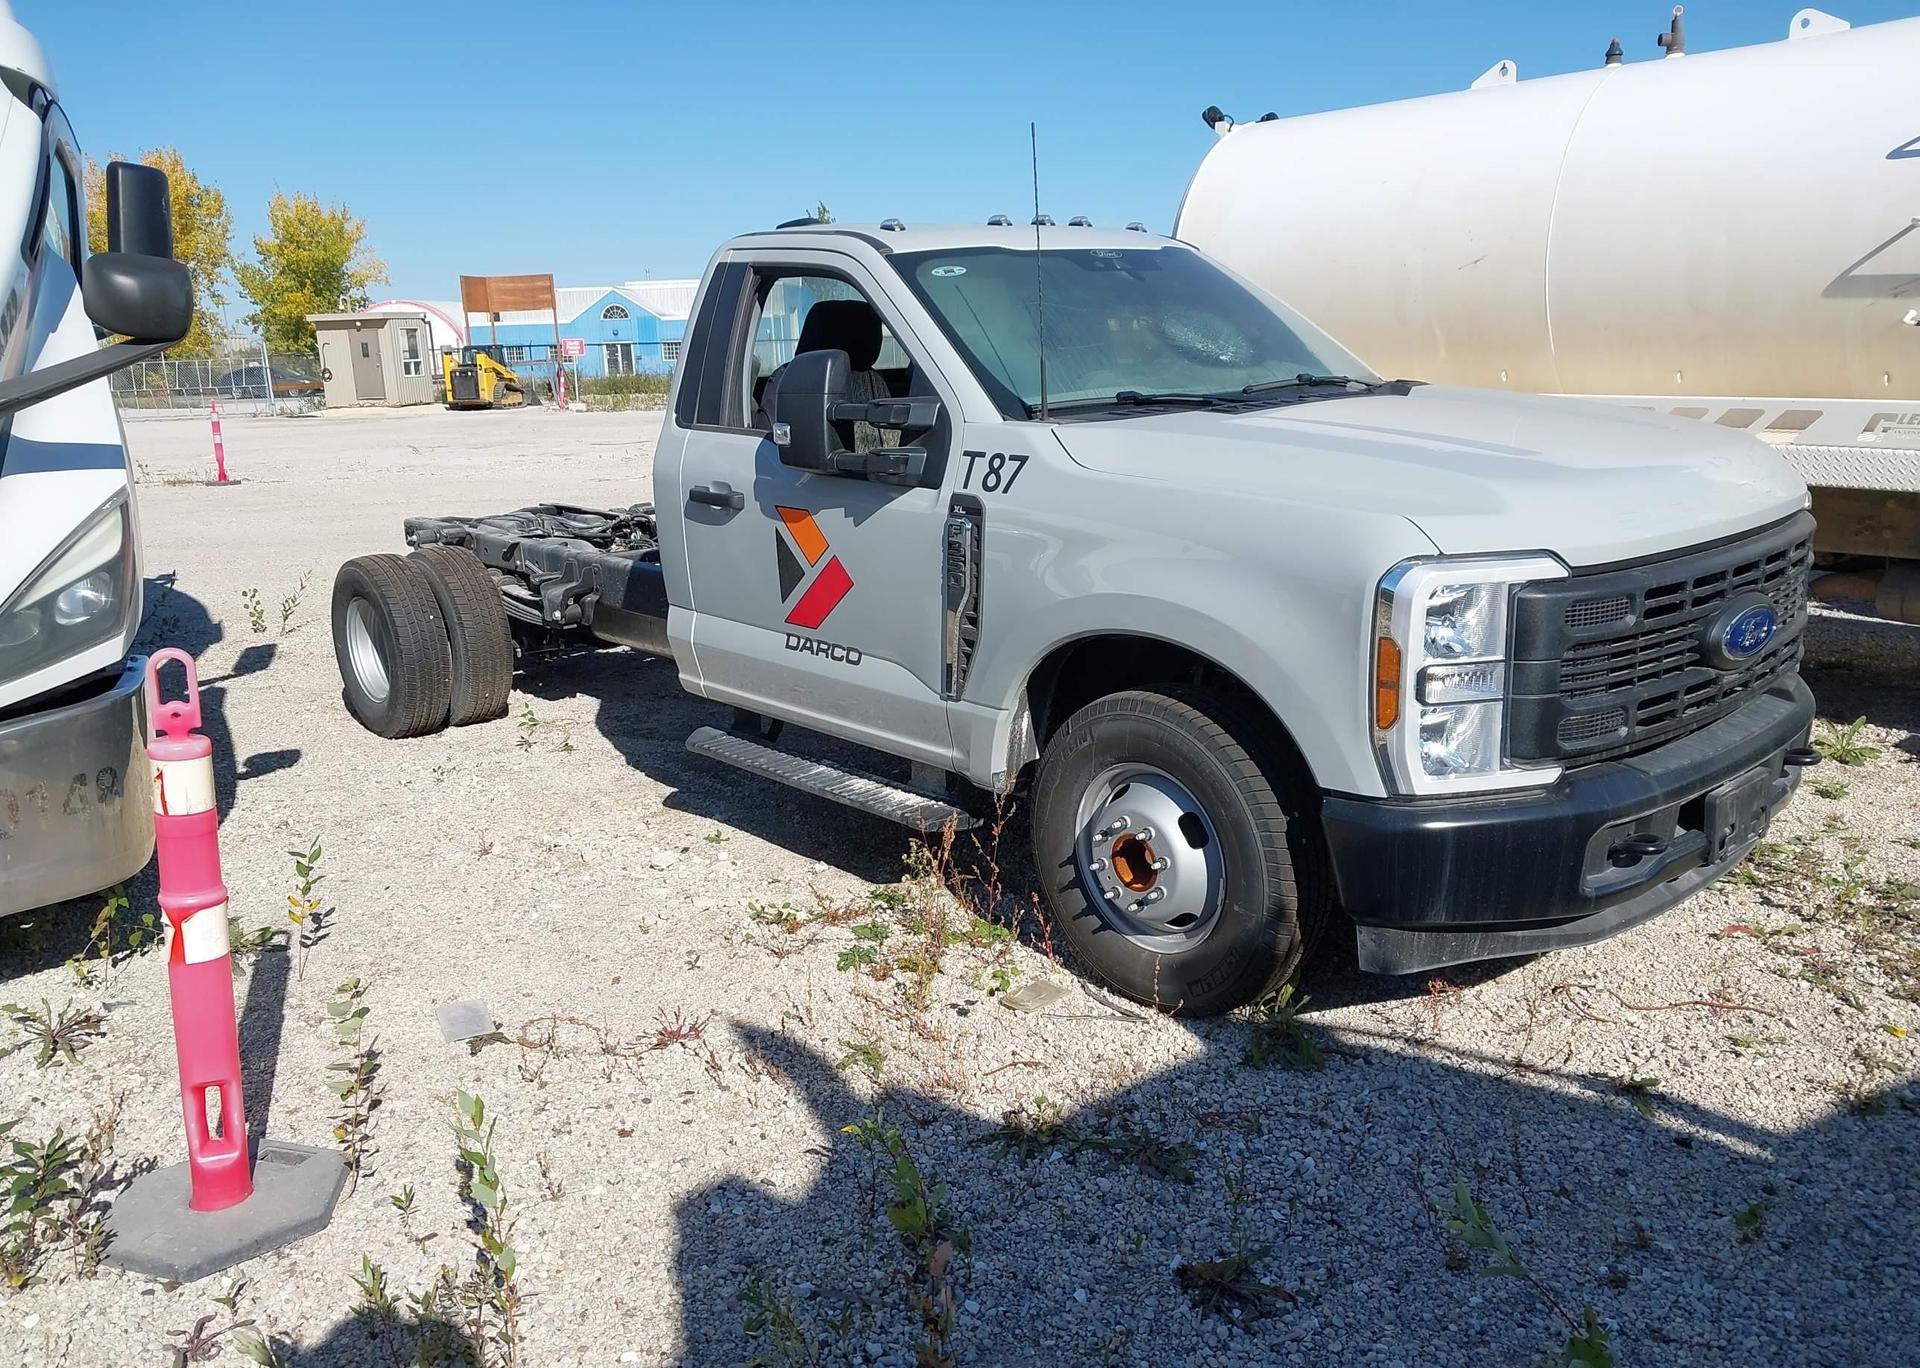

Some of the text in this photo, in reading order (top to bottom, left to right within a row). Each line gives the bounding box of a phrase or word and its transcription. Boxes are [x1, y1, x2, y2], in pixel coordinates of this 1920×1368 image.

[962, 450, 1030, 494] T87
[953, 505, 967, 514] XL
[785, 632, 863, 666] DARCO
